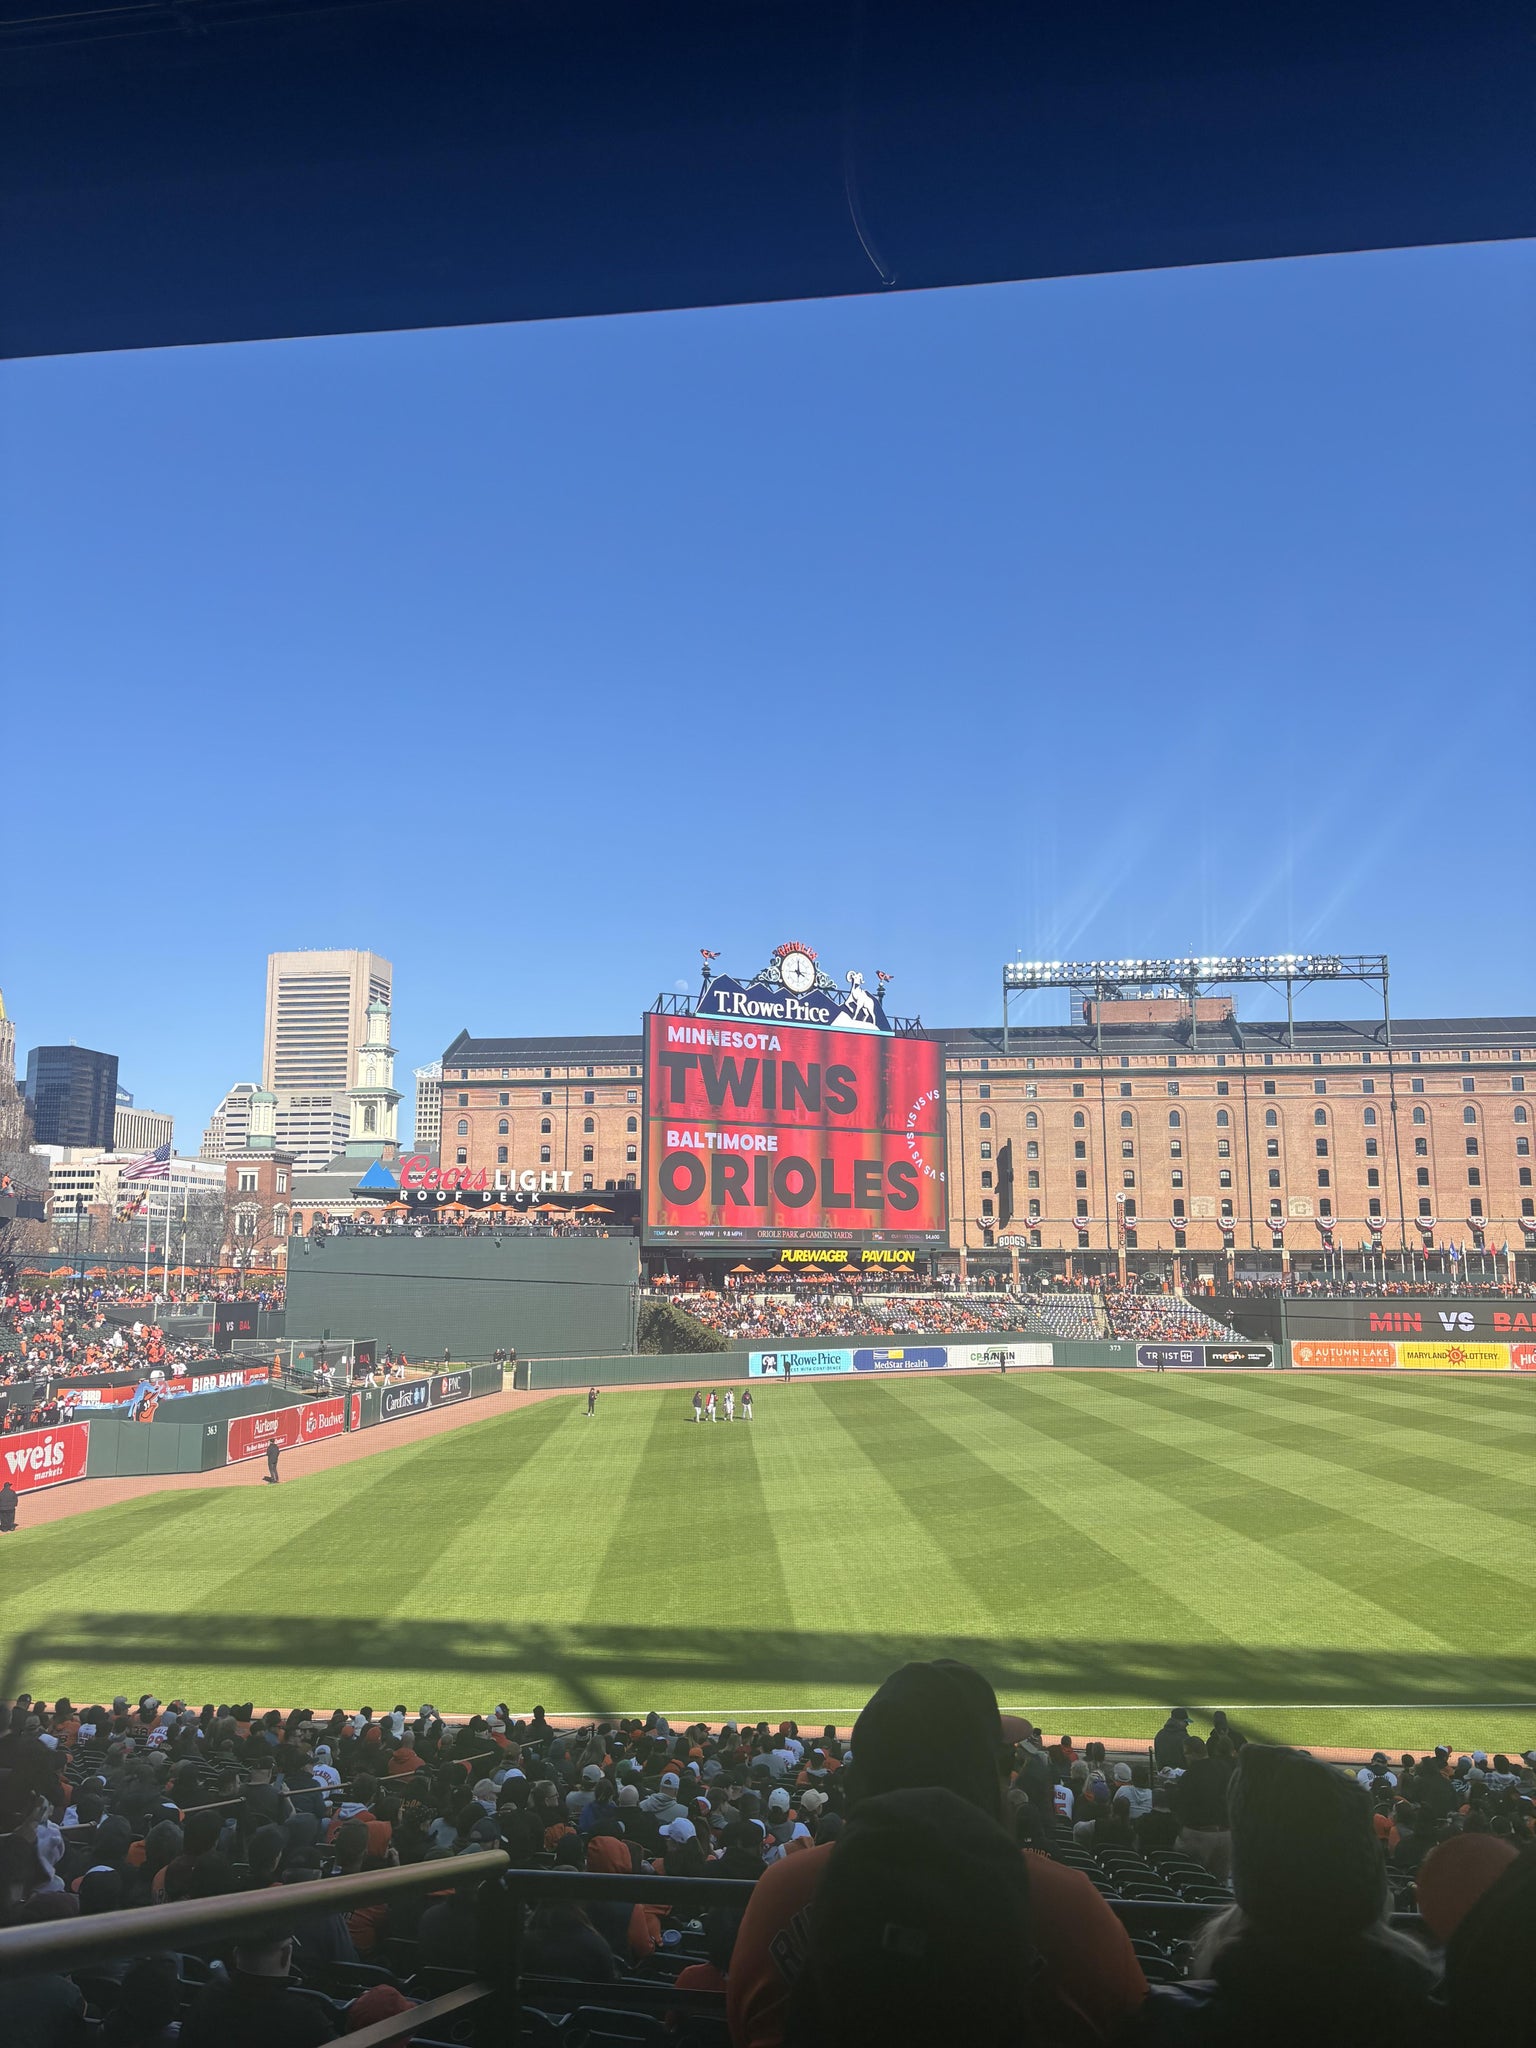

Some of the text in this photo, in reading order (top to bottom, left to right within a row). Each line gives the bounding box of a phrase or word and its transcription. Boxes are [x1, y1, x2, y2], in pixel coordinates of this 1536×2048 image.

[667, 1025, 782, 1051] MINNESOTA
[658, 1050, 858, 1115] TWINS
[926, 1089, 940, 1101] VS
[913, 1097, 926, 1111] VS
[906, 1112, 917, 1128] VS
[666, 1130, 778, 1152] BALTIMORE
[906, 1132, 915, 1149] VS
[912, 1151, 923, 1168] VS
[400, 1154, 574, 1192] Coors LIGHT
[923, 1165, 936, 1180] VS
[658, 1150, 919, 1211] ORIOLES
[400, 1190, 540, 1203] ROOF DECK
[757, 1230, 781, 1238] ORIOLE
[805, 1231, 832, 1239] CAMDEN
[833, 1231, 853, 1239] YARDS
[781, 1250, 915, 1263] PUREWAGER PAVILION
[226, 1321, 234, 1331] VS
[239, 1320, 250, 1331] BAL
[1369, 1312, 1422, 1332] MIN
[1438, 1312, 1475, 1332] VS
[818, 1352, 841, 1364] Price
[1315, 1348, 1359, 1356] AUTUMN
[1465, 1352, 1498, 1360] LOTTERY
[874, 1359, 928, 1369] MedStar Health
[192, 1375, 217, 1393] BIRD
[219, 1371, 244, 1388] BATH
[448, 1377, 461, 1391] PNC
[82, 1390, 101, 1401] BIRD
[386, 1390, 414, 1411] CareFirst
[207, 1425, 217, 1435] 363
[254, 1418, 279, 1436] Airtemp
[4, 1436, 65, 1475] weis
[34, 1467, 63, 1481] markets
